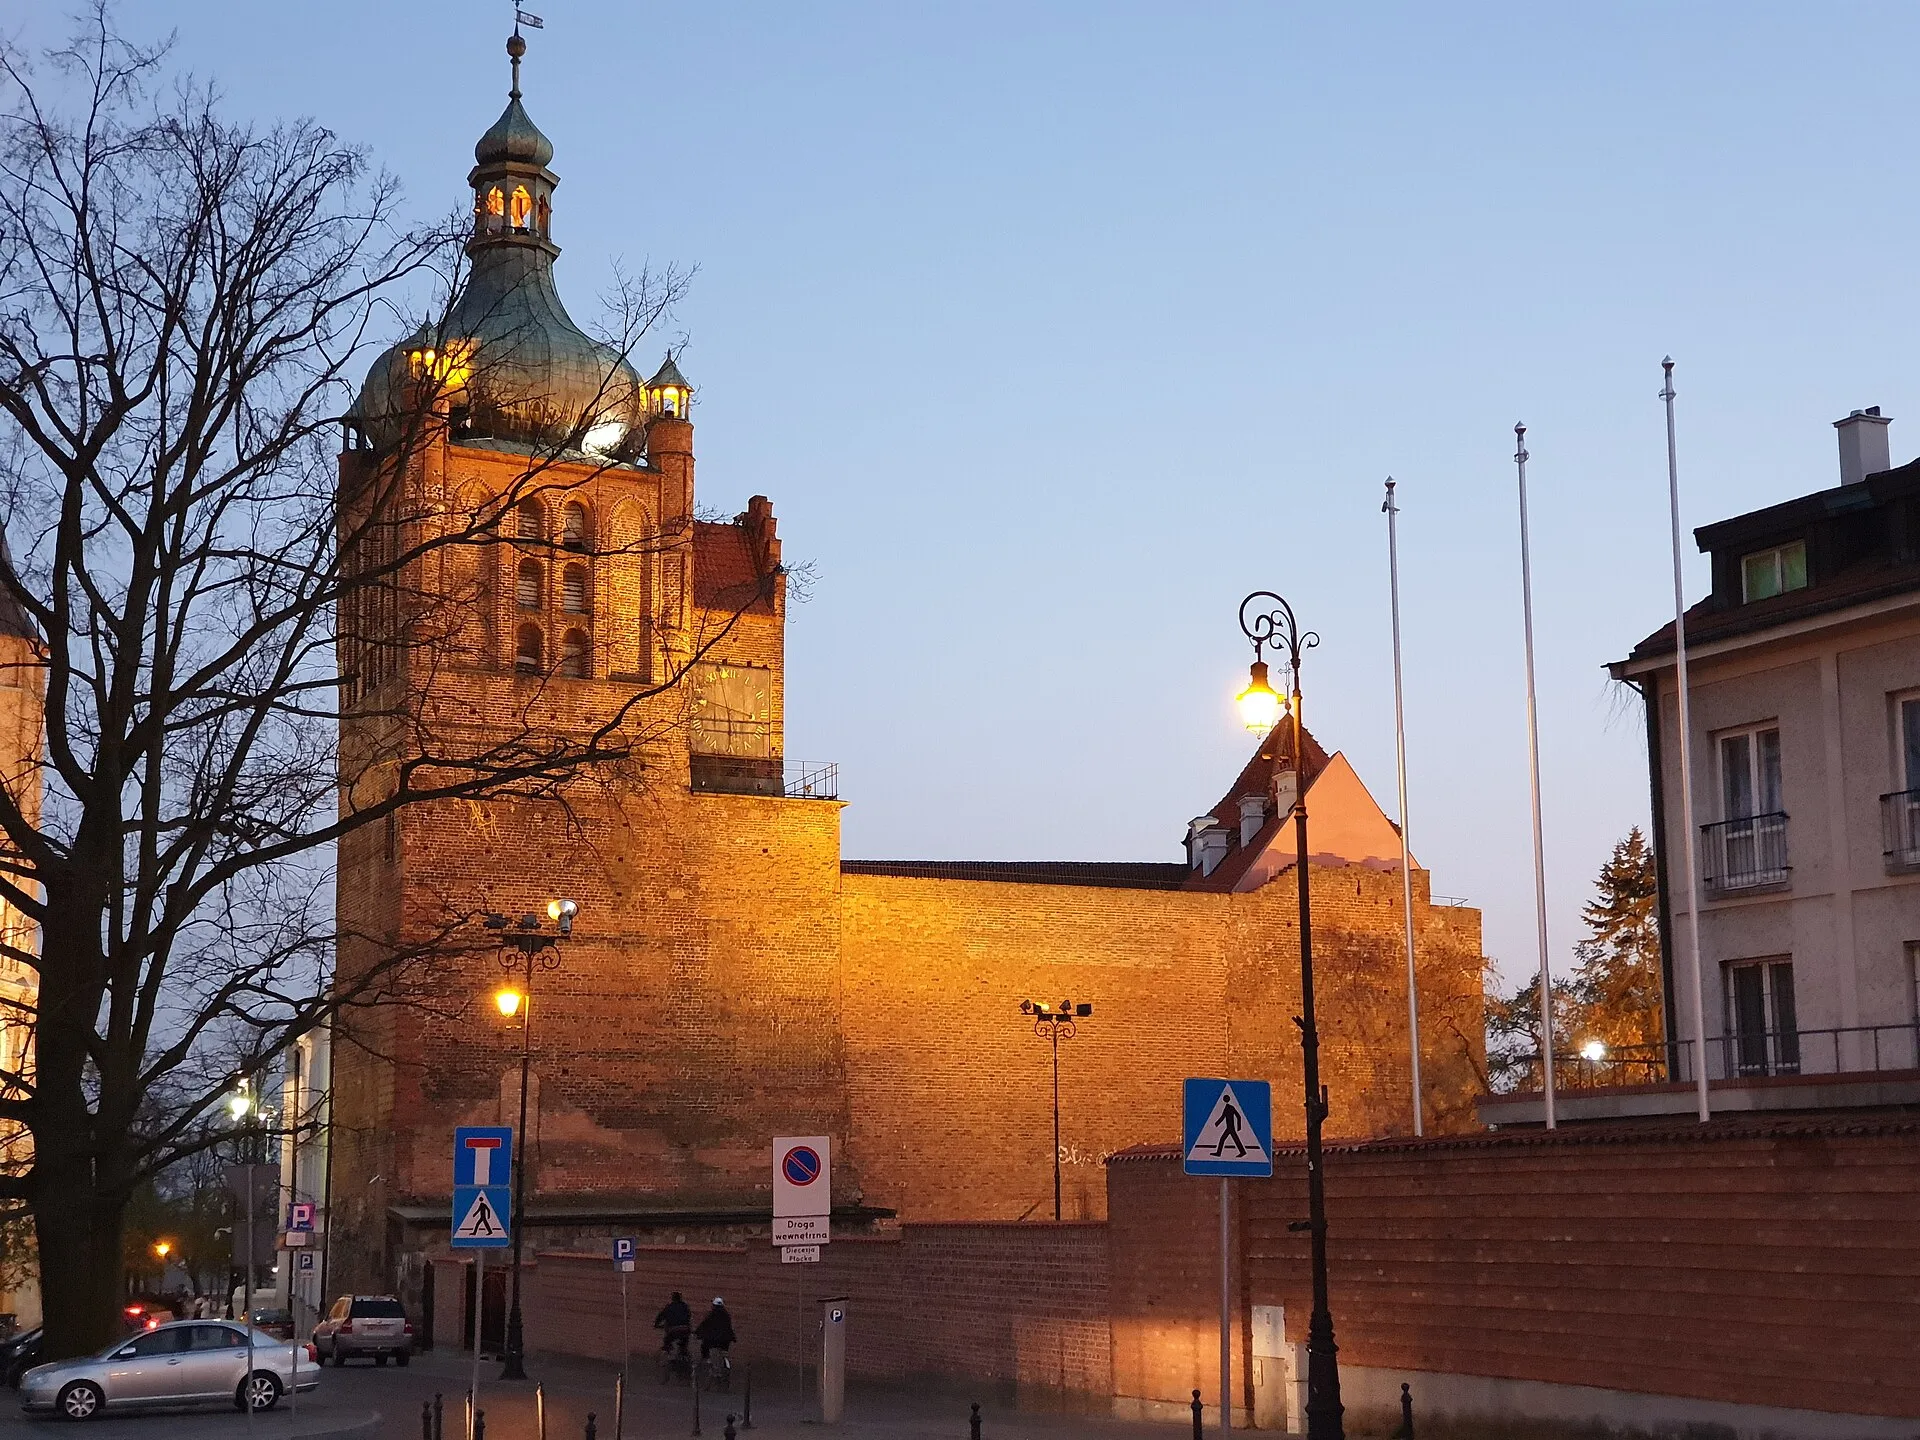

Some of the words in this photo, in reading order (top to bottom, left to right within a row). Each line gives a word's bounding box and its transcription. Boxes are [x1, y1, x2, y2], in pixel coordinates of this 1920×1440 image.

[293, 1206, 309, 1228] P
[787, 1220, 815, 1230] Droga
[775, 1232, 827, 1241] wewnętrzna
[618, 1240, 630, 1258] P
[302, 1256, 310, 1267] P
[833, 1310, 841, 1320] P
